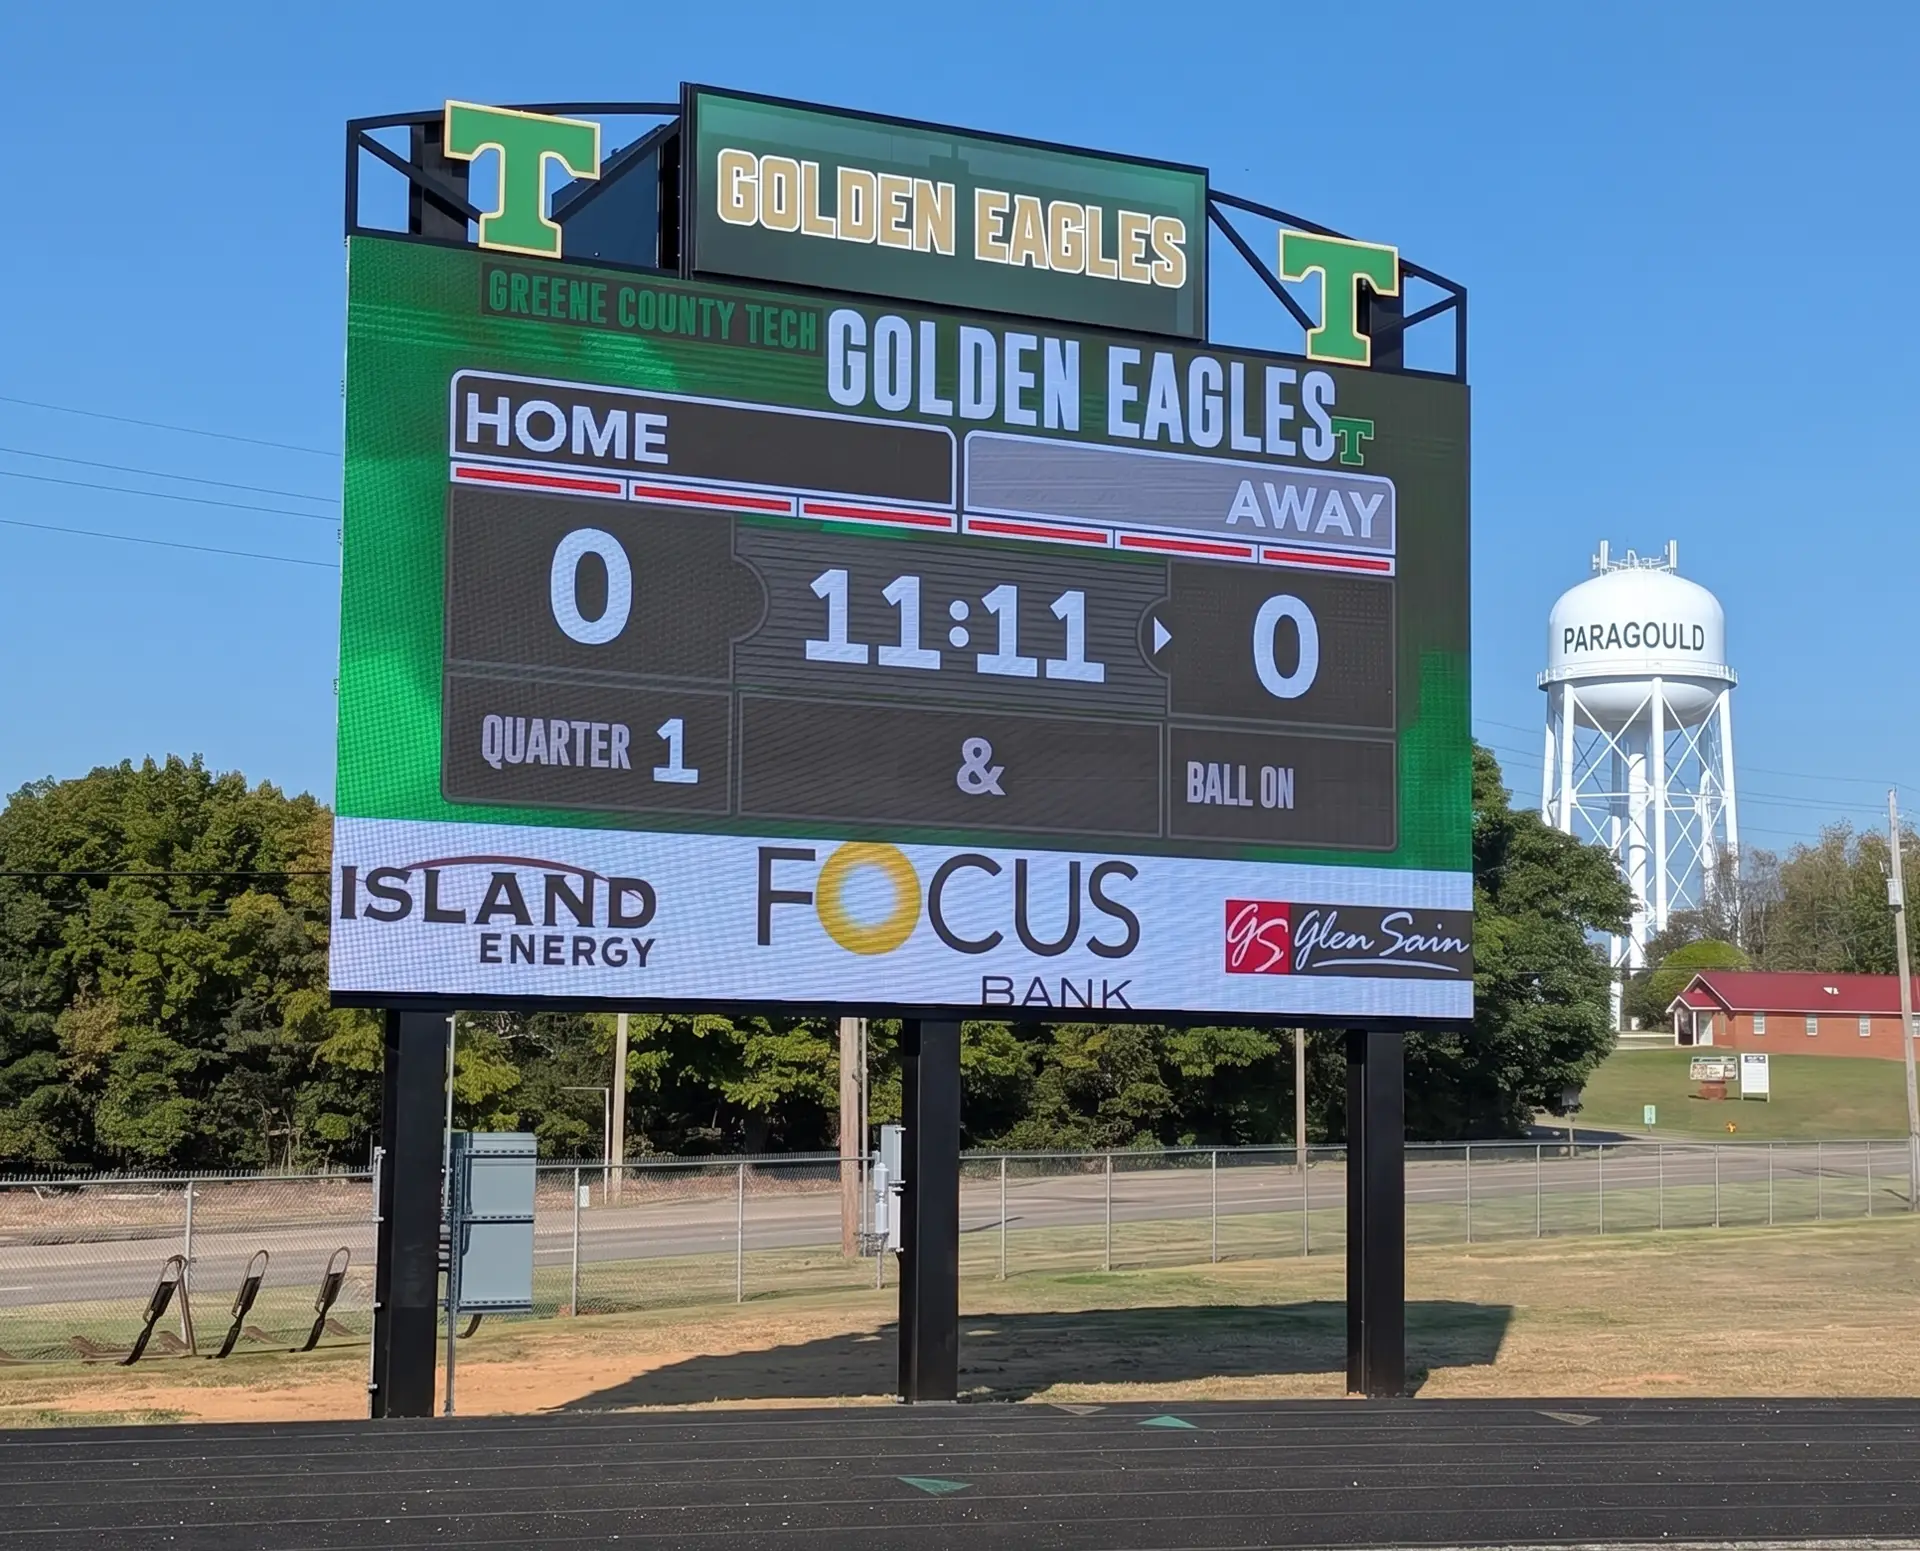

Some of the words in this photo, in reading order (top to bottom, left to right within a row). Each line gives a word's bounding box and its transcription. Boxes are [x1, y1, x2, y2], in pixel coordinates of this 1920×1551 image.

[444, 99, 601, 259] T
[717, 147, 956, 257] GOLDEN
[974, 187, 1187, 289] EAGLES
[488, 268, 608, 325] GREENE
[617, 286, 735, 337] COUNTY
[745, 303, 818, 352] TECH
[1278, 227, 1399, 367] T
[827, 307, 1081, 432] GOLDEN
[1107, 345, 1337, 462] EAGLES
[465, 391, 670, 465] HOME
[1225, 479, 1385, 539] AWAY
[549, 527, 633, 646] 0
[804, 568, 1106, 684] 11:11
[1252, 593, 1320, 700] 0
[1563, 621, 1705, 655] PARAGOULD
[481, 713, 632, 770] QUARTER
[652, 717, 699, 785] 1
[955, 736, 1007, 797] &
[1186, 760, 1253, 808] BALL
[1259, 765, 1295, 810] ON
[340, 864, 657, 930] ISLAND
[757, 839, 1141, 958] FOCUS
[478, 931, 657, 968] ENERGY
[1294, 909, 1376, 971] Glen
[1378, 910, 1470, 957] Sain
[982, 975, 1133, 1010] BANK
